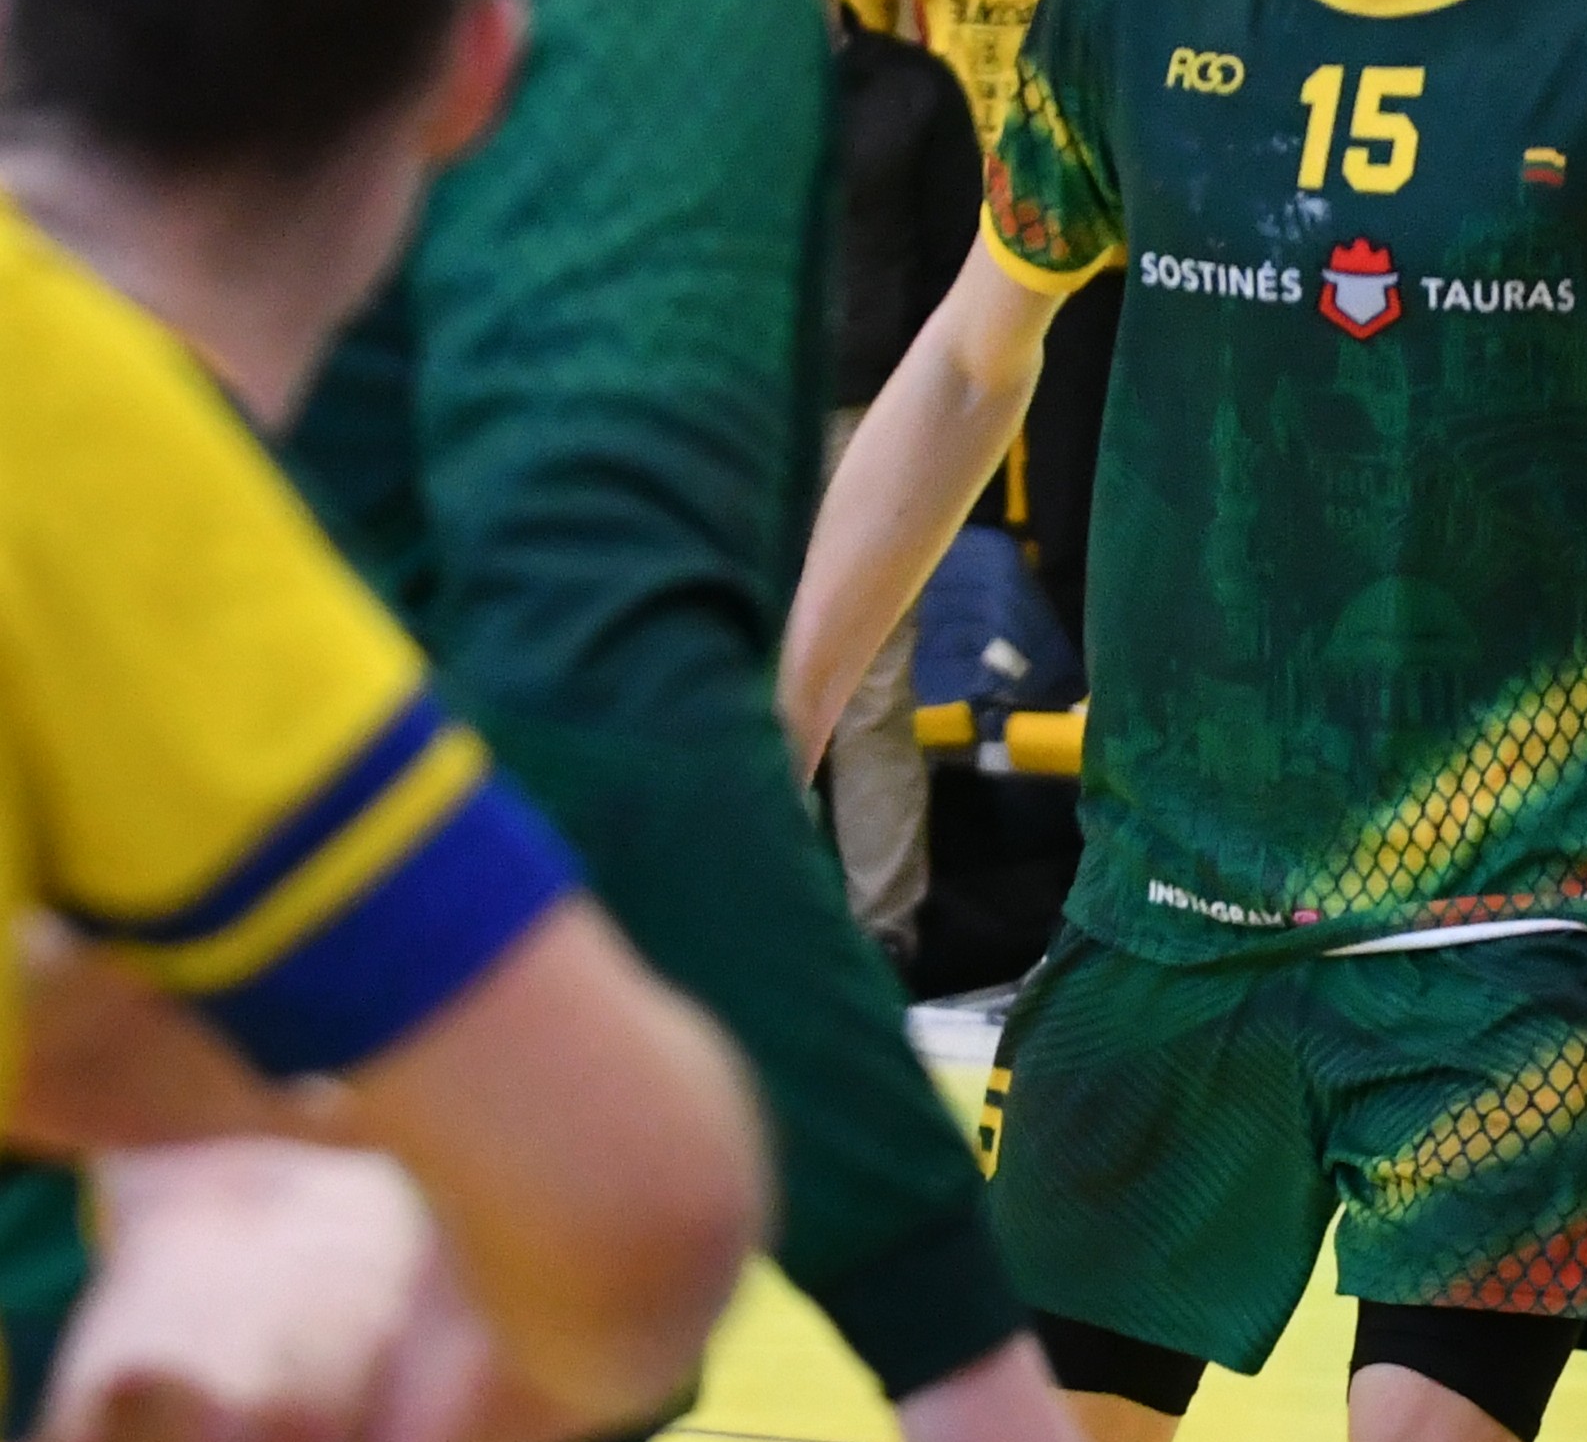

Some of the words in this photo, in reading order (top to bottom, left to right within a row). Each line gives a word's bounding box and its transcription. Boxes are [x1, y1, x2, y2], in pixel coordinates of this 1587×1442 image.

[1296, 63, 1426, 194] 15
[1140, 250, 1303, 303] SOSTINĖS
[1420, 276, 1576, 313] TAURAS
